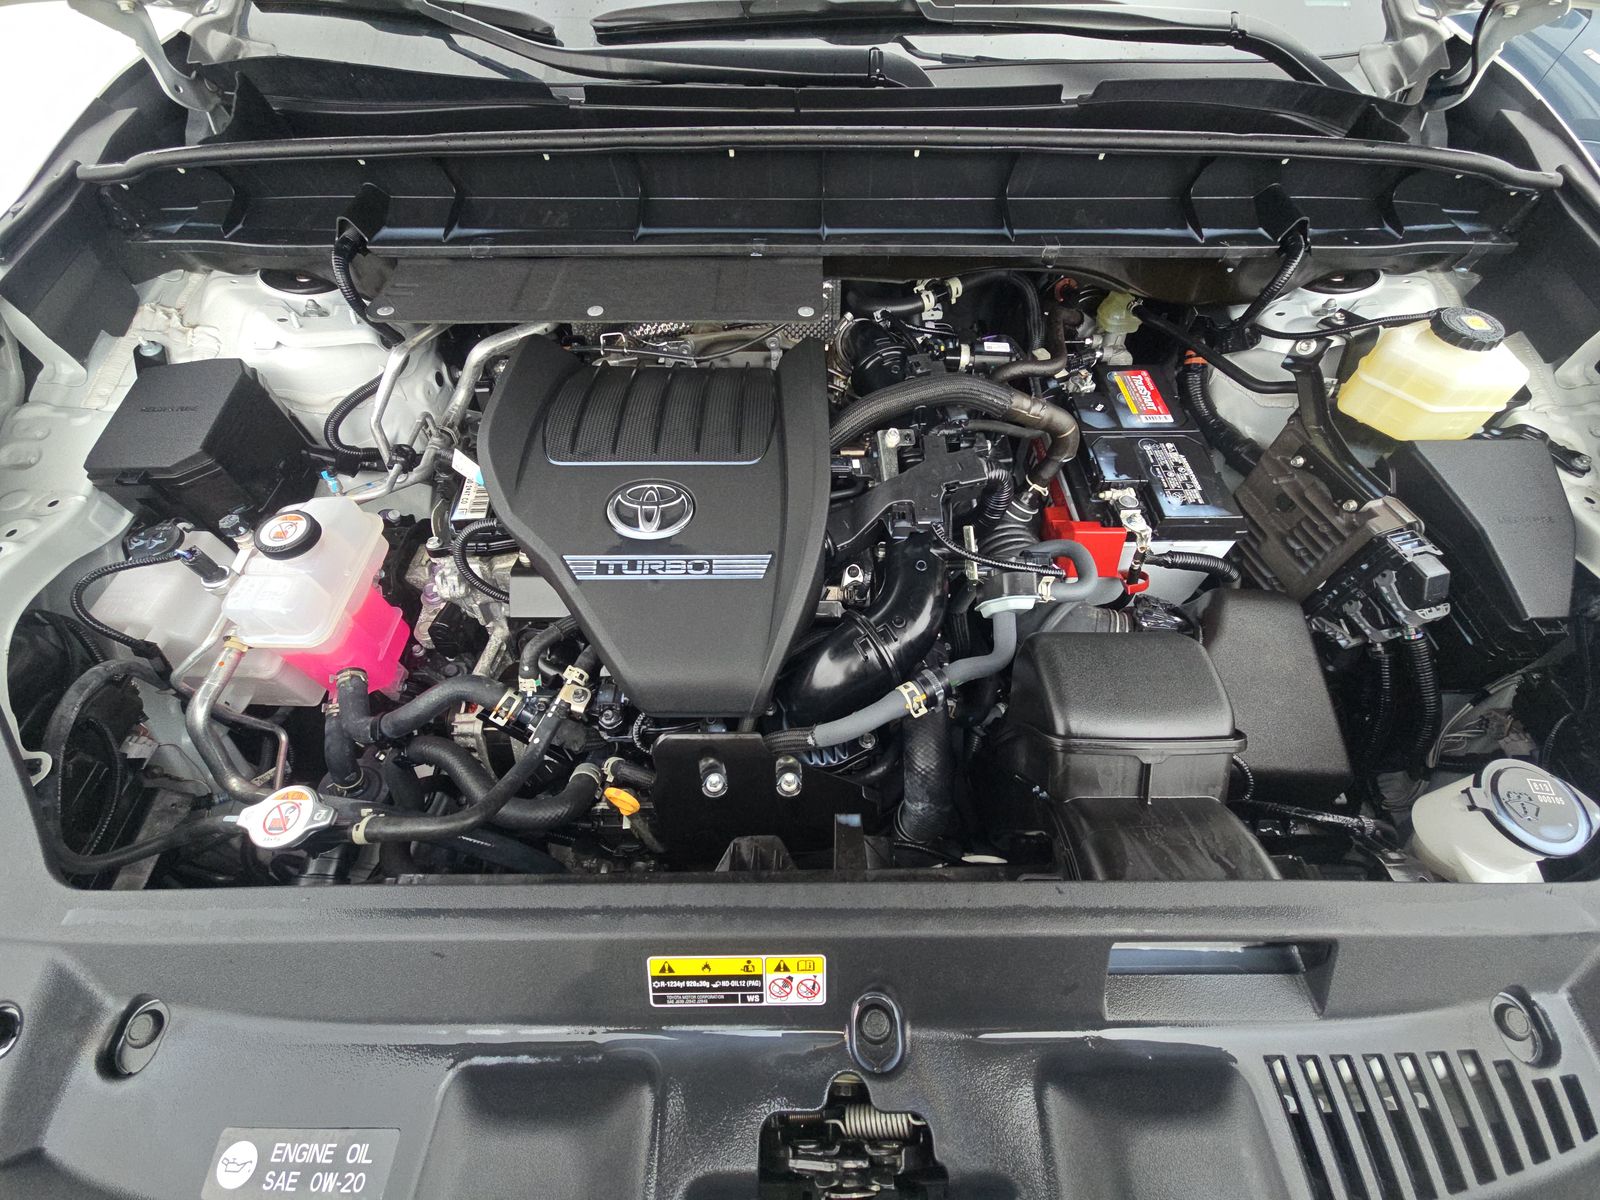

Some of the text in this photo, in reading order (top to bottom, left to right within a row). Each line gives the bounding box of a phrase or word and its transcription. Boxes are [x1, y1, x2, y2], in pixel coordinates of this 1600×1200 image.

[600, 559, 710, 575] TURBO
[746, 994, 760, 1002] WS
[270, 1143, 373, 1164] ENGINE OIL
[262, 1171, 366, 1193] SAE 0W-20
